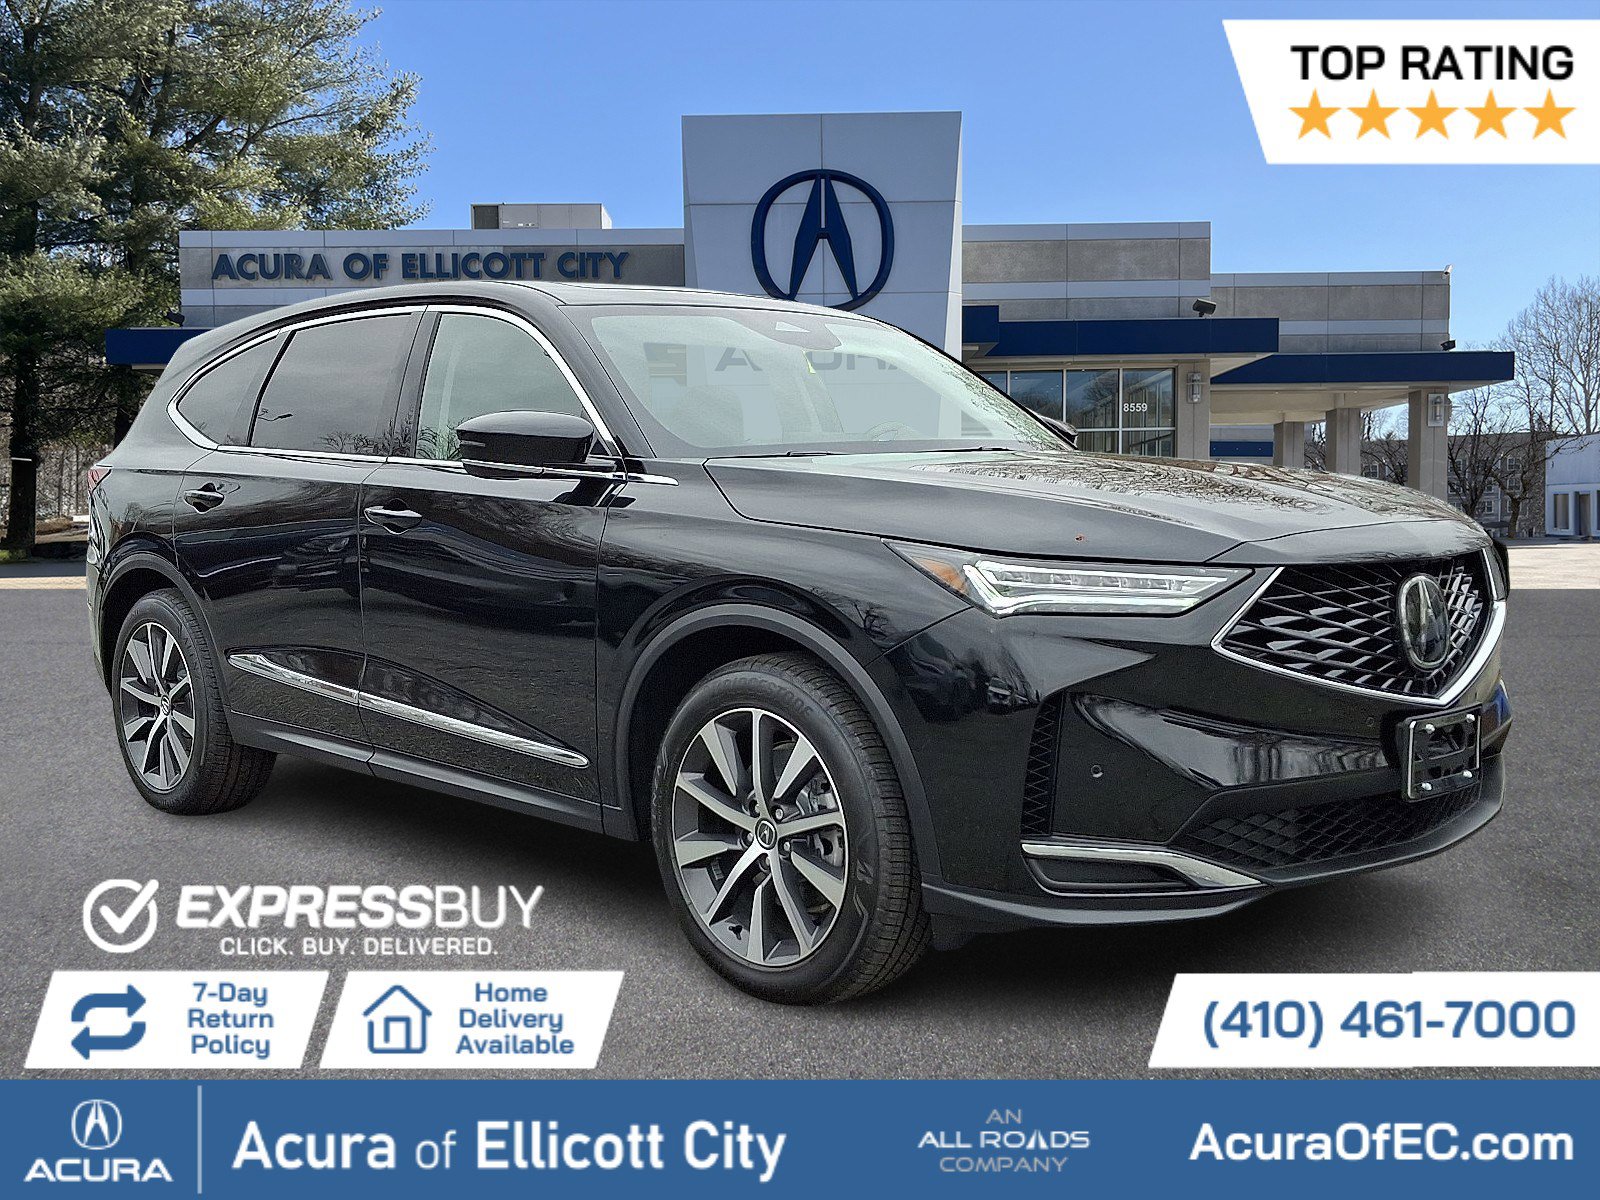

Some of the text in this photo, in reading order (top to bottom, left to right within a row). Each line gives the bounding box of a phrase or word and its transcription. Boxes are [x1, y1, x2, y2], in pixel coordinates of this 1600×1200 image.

[211, 251, 631, 281] ACURA OF ELLICOTT CITY
[1122, 402, 1149, 413] 8559
